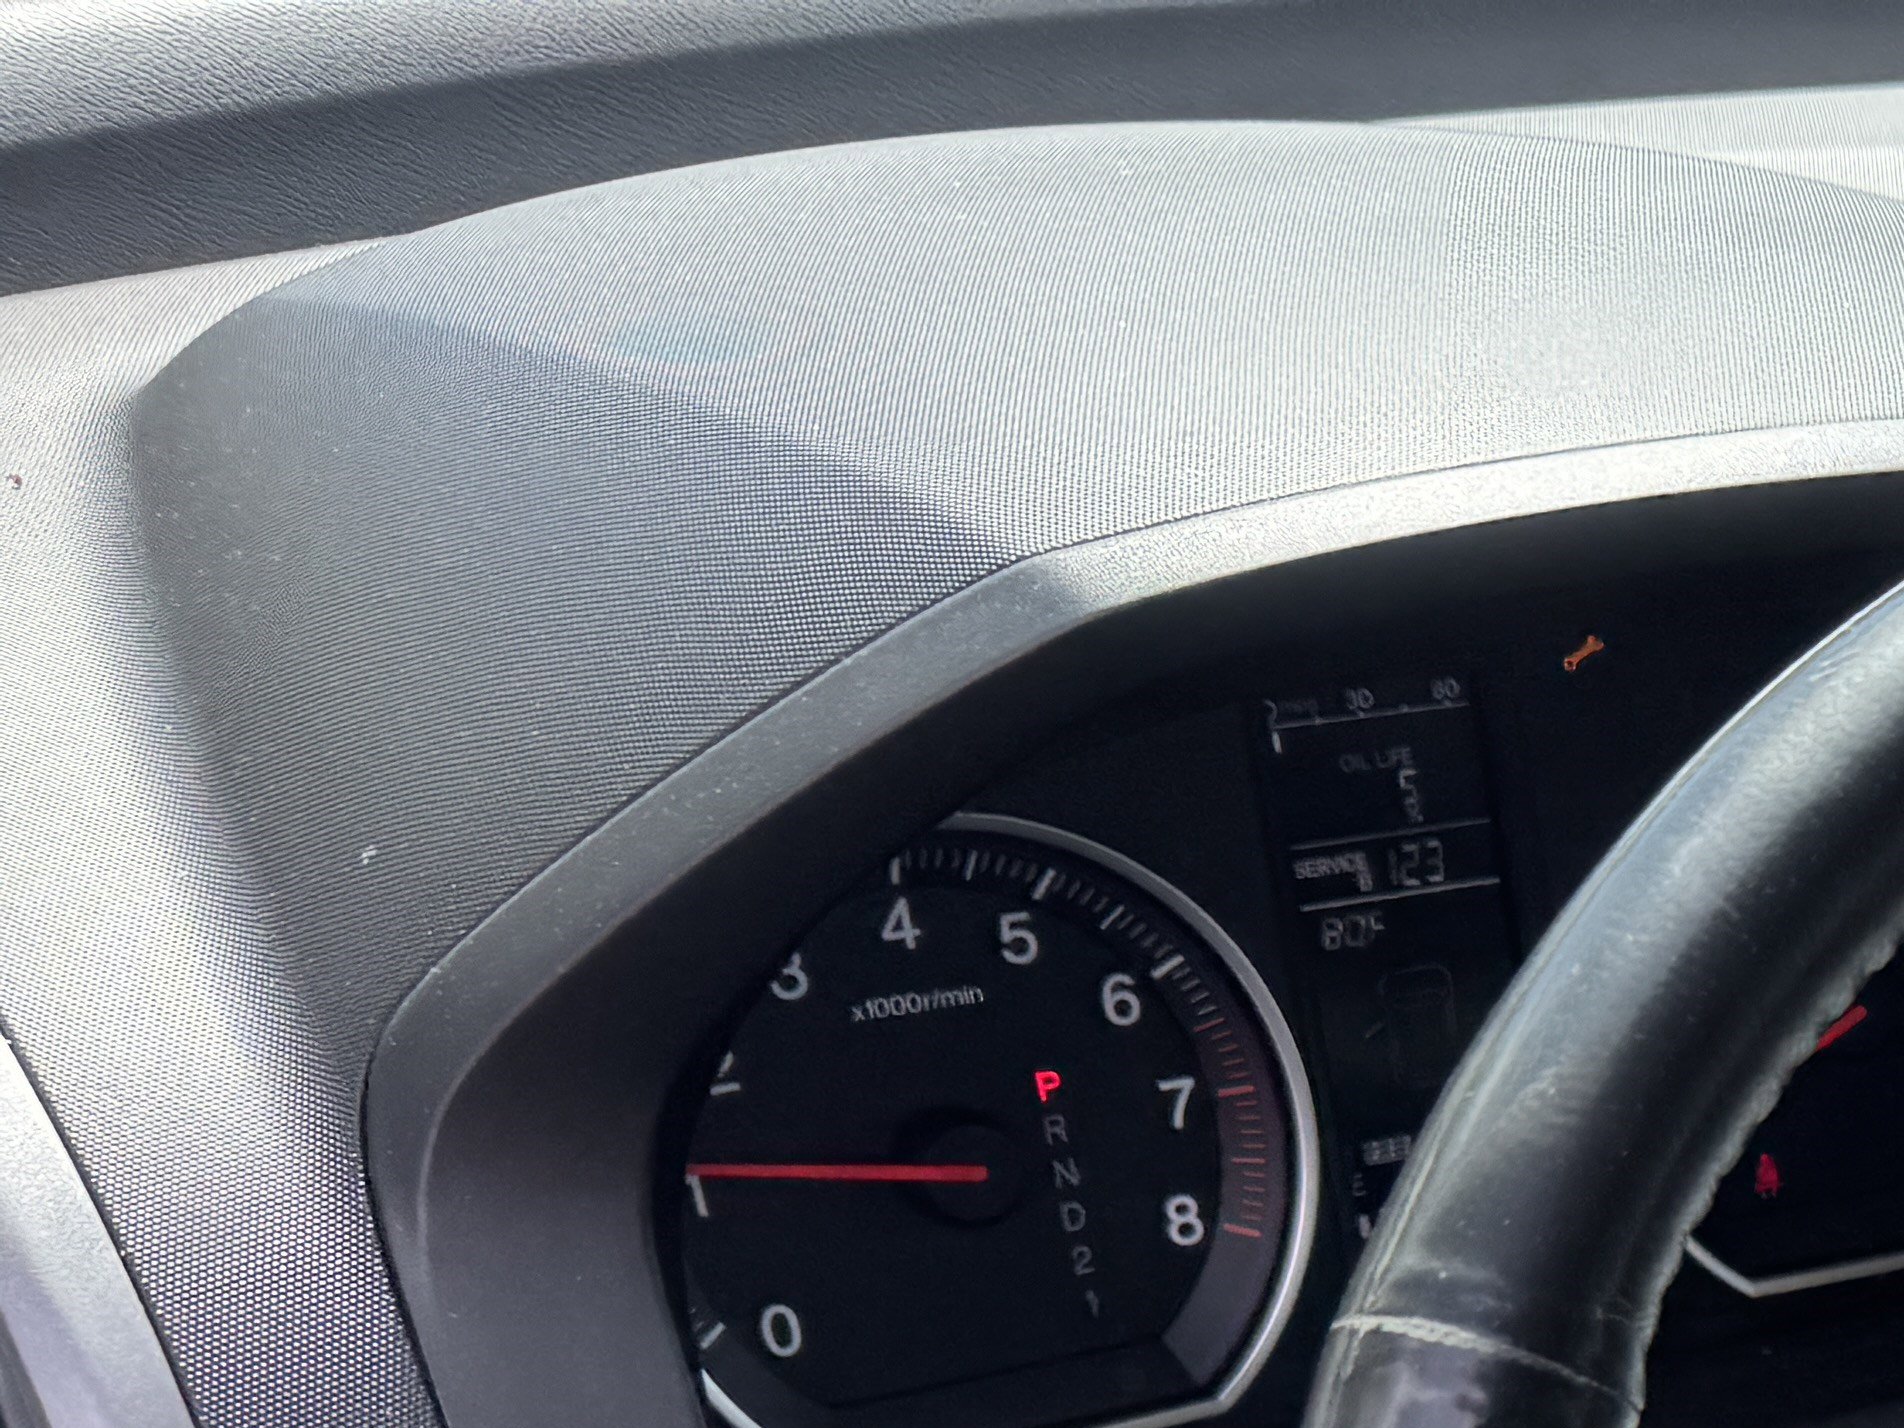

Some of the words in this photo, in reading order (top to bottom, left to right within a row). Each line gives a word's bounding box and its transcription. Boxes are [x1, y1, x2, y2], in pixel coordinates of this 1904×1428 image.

[880, 896, 922, 951] 4
[999, 911, 1040, 966] 5
[850, 984, 985, 1022] x1000r/min
[1101, 972, 1143, 1027] 6
[1033, 1069, 1063, 1103] P
[1156, 1075, 1196, 1130] 7
[1043, 1114, 1069, 1145] R
[1052, 1156, 1082, 1189] N
[1060, 1201, 1087, 1232] D
[1164, 1193, 1205, 1247] 8
[1072, 1245, 1096, 1277] 2
[760, 1302, 802, 1358] 0
